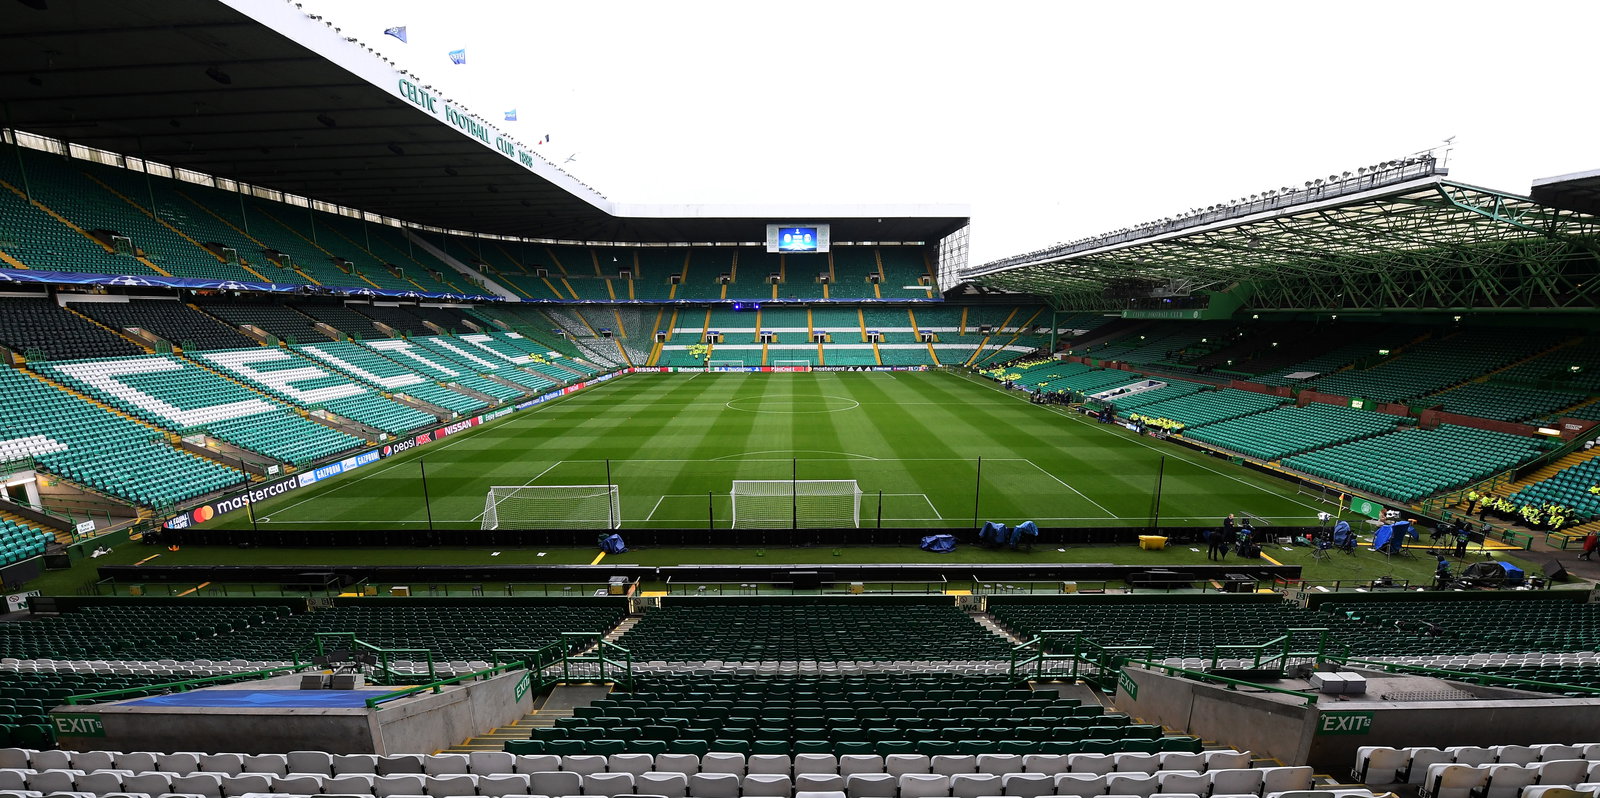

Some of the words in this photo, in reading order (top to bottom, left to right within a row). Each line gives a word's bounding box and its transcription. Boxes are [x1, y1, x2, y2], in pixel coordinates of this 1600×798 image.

[398, 79, 438, 114] CELTIC
[445, 104, 491, 144] FOOTBALL
[496, 136, 515, 158] CLUB
[518, 150, 533, 168] 1888
[485, 413, 495, 422] Enjoy
[444, 420, 472, 436] NISSAN
[393, 437, 415, 455] pepsi
[416, 432, 432, 447] MAX
[357, 449, 380, 465] GAZPROM
[316, 463, 341, 479] GAZPROM
[217, 477, 297, 514] mastercard
[516, 675, 528, 698] EXIT
[1120, 673, 1136, 695] EXIT
[55, 718, 95, 733] EXIT
[1323, 716, 1367, 730] EXIT
